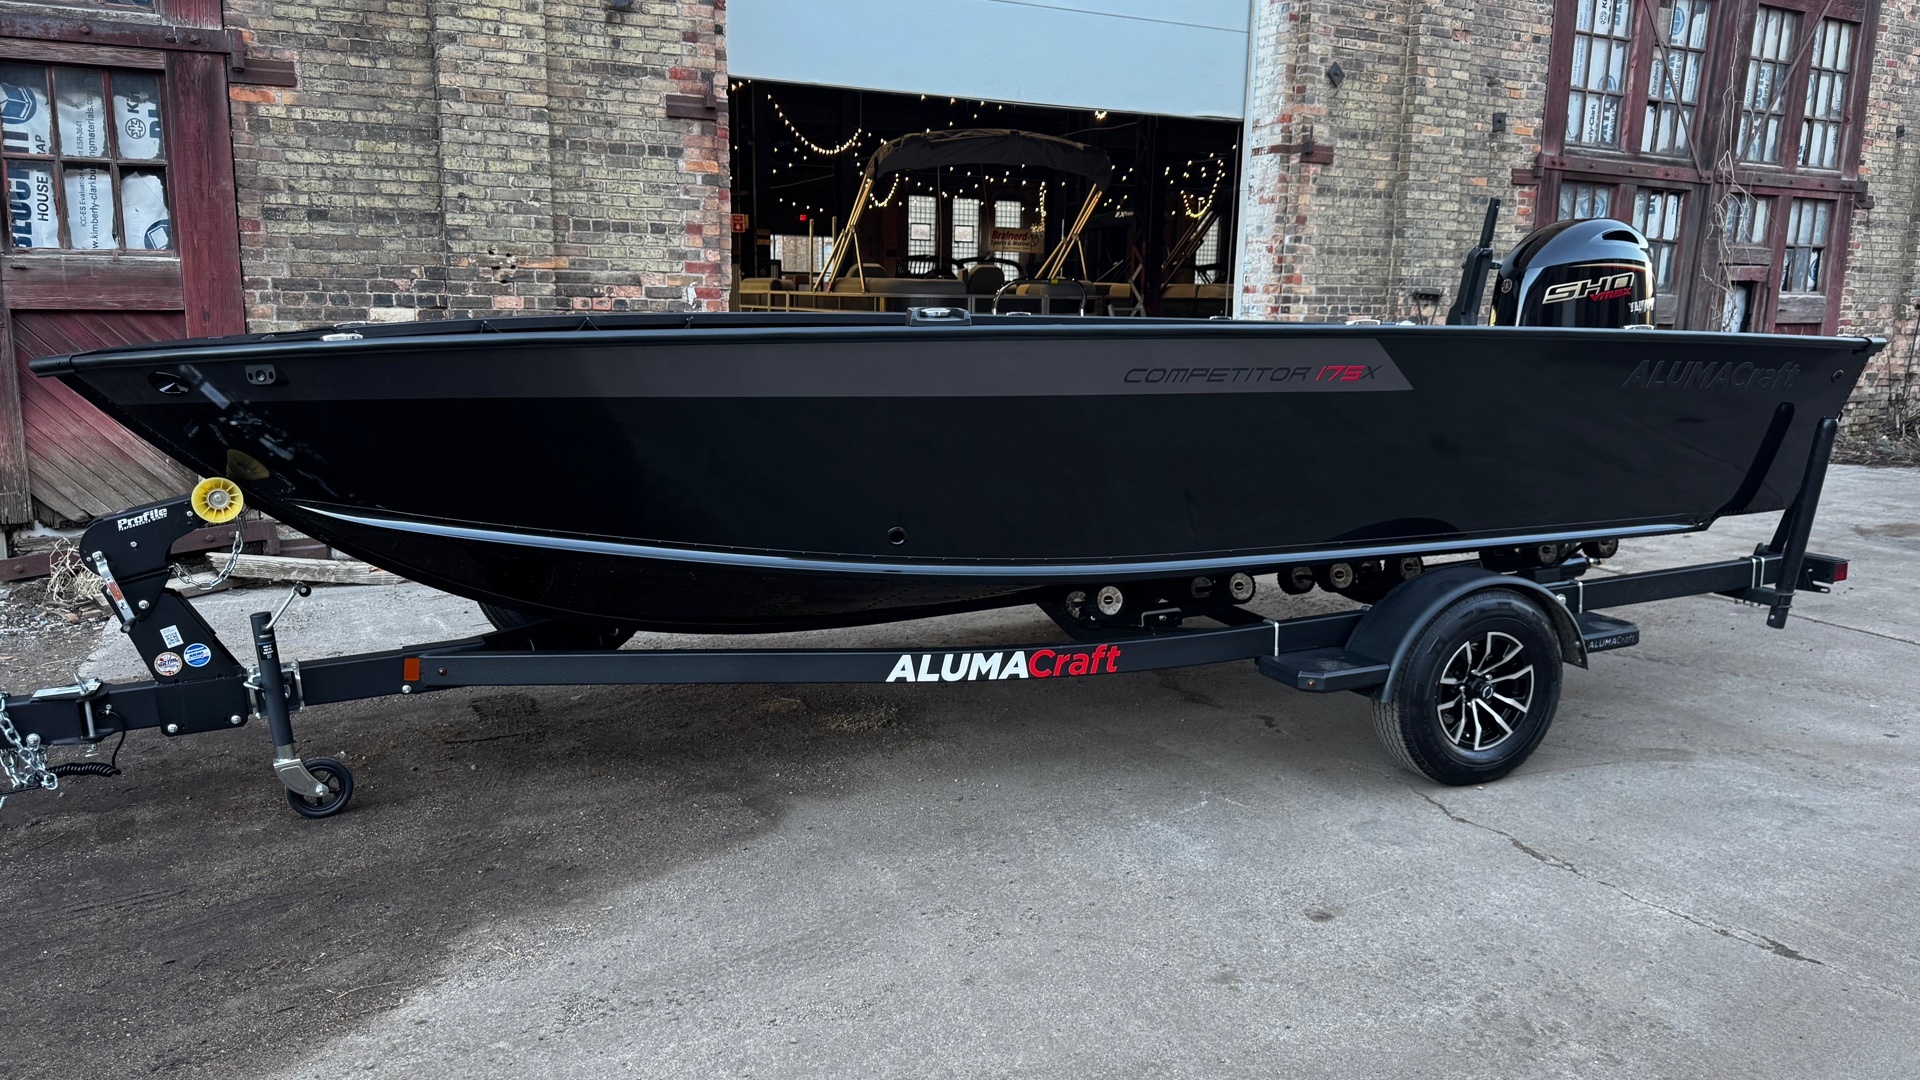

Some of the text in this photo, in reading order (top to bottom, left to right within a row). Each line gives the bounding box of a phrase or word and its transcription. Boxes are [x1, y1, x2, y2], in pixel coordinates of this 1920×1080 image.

[36, 176, 49, 222] HOUSE
[1542, 271, 1635, 304] SHO
[1123, 366, 1313, 384] COMPETITOR
[1621, 359, 1801, 390] ALUMACraft
[117, 507, 168, 529] Profile
[1587, 634, 1636, 650] ALUMACraft
[885, 643, 1122, 683] ALUMACraft
